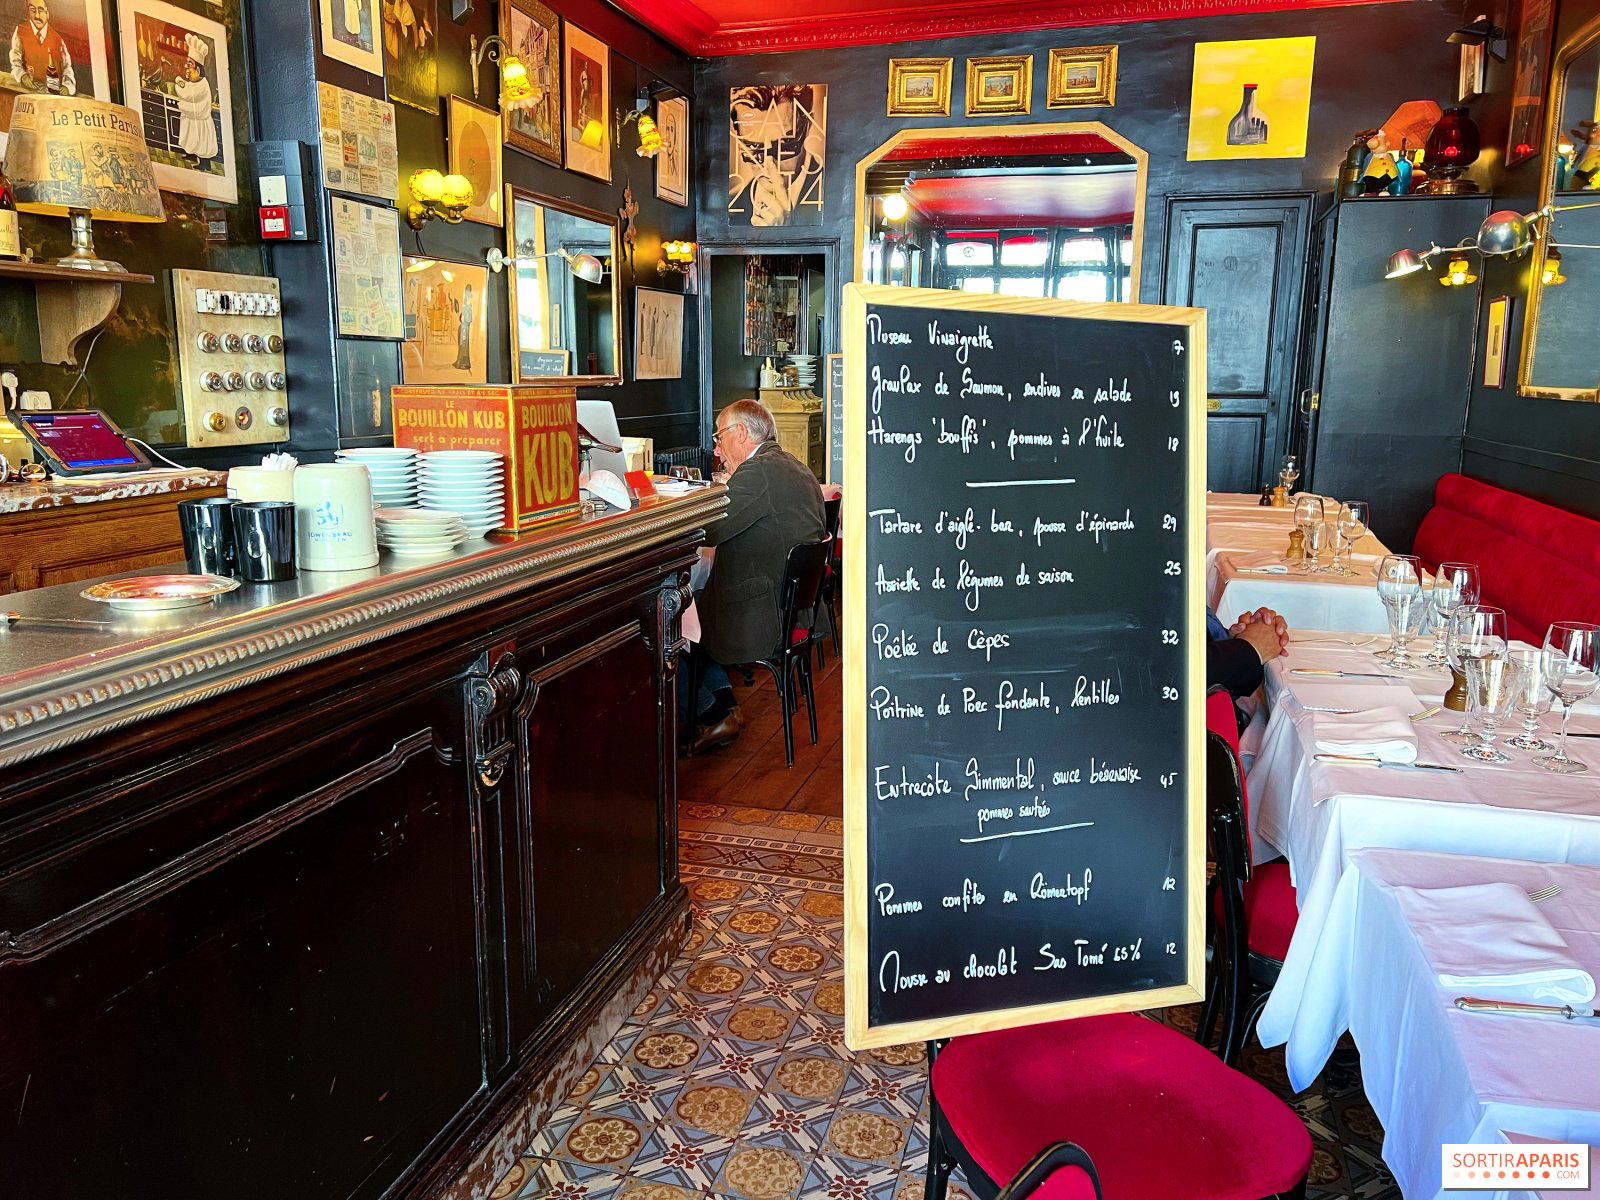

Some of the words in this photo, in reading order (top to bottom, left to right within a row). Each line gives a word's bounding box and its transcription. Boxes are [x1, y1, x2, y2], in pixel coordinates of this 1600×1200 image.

[50, 110, 69, 127] Le
[73, 109, 107, 129] Petit
[928, 319, 994, 365] Vinaigrette
[1172, 339, 1185, 356] 7
[445, 399, 455, 409] LE
[934, 371, 950, 396] de
[959, 367, 1012, 402] Saumon,
[1022, 372, 1061, 398] endives
[1071, 387, 1085, 400] en
[1093, 377, 1132, 404] salade
[1169, 390, 1180, 408] 19
[397, 408, 468, 429] BOUILLON
[473, 410, 505, 430] KUB
[521, 402, 572, 429] BOUILLON
[413, 431, 434, 444] sert
[866, 415, 923, 464] Harengs
[1007, 428, 1053, 461] pommes
[1061, 427, 1070, 445] à
[1078, 414, 1125, 448] l'huile
[1168, 436, 1180, 452] 18
[522, 430, 575, 508] KUB
[868, 508, 923, 535] Tartare
[1162, 513, 1177, 533] 29
[874, 563, 921, 595] Assiette
[931, 566, 947, 590] de
[956, 558, 1004, 612] légumes
[1015, 562, 1031, 586] de
[1037, 567, 1075, 585] saison
[1163, 560, 1182, 576] 25
[871, 623, 919, 661] Poêlée
[932, 626, 950, 655] de
[967, 628, 1010, 662] Cèpes
[1161, 629, 1179, 645] 32
[869, 685, 925, 721] Poitrine
[937, 693, 952, 716] de
[962, 687, 988, 714] Porc
[1070, 675, 1120, 708] lentilles
[1162, 686, 1179, 701] 30
[874, 761, 952, 801] Entrecôte
[1052, 768, 1082, 786] sauce
[1160, 772, 1178, 789] 45
[977, 808, 1014, 833] pommes
[1018, 795, 1051, 819] sautées
[874, 882, 923, 917] Pommes
[942, 877, 986, 913] confites
[1002, 890, 1018, 904] en
[1162, 876, 1176, 891] 12
[934, 969, 951, 984] au
[963, 946, 1018, 979] chocolat
[1074, 939, 1108, 967] Tomé
[1166, 942, 1177, 955] 12
